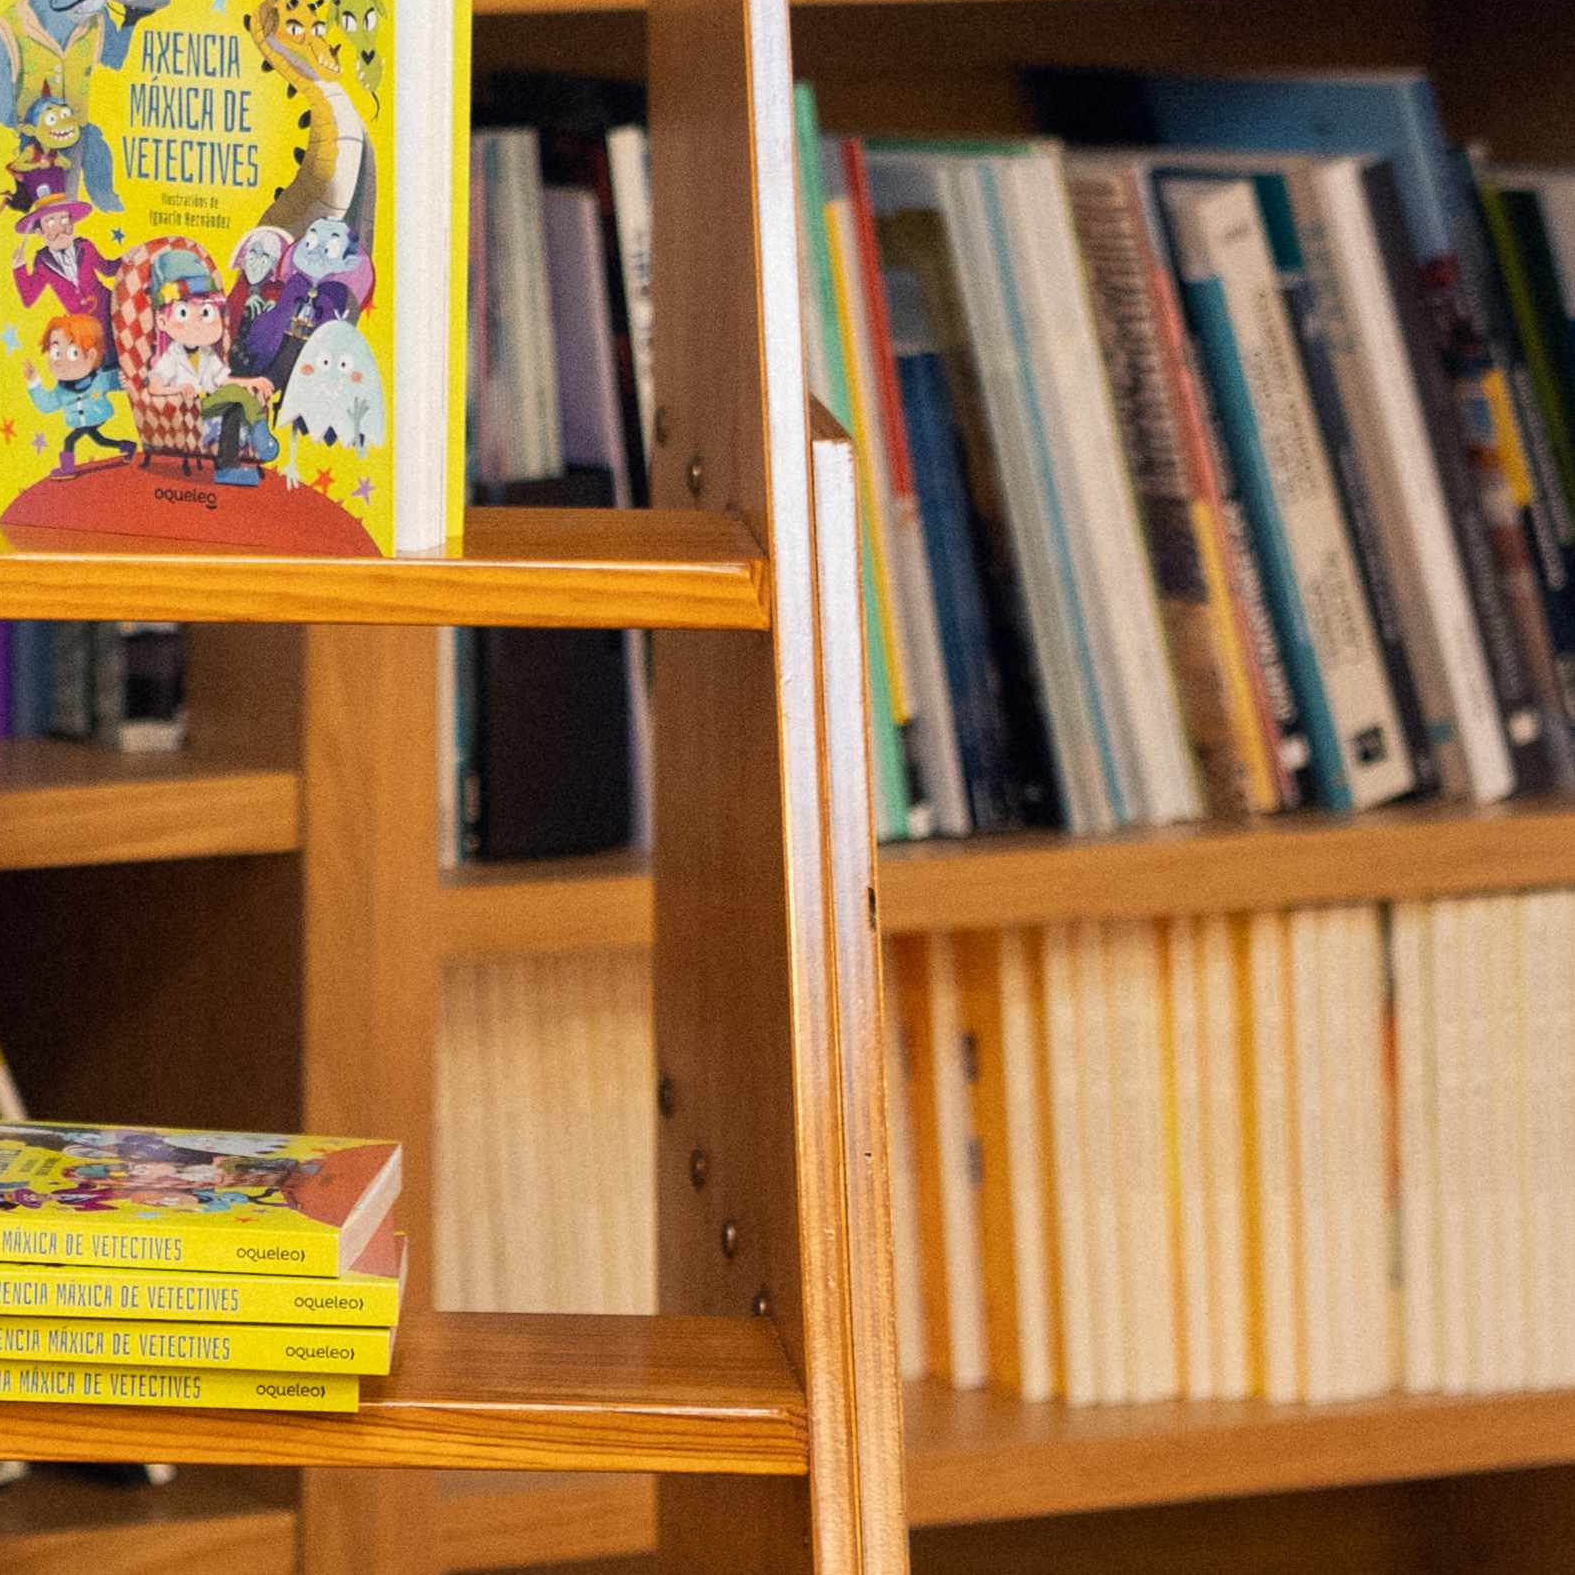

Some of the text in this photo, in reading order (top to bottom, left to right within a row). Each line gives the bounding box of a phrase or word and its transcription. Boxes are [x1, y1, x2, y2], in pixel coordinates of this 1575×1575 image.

[142, 30, 240, 79] AXENCIA
[130, 76, 251, 132] MÁXICA DE
[122, 136, 259, 187] VETECTIVES
[210, 196, 219, 209] de
[154, 488, 217, 509] oqueleo
[2, 1226, 57, 1255] MÁXICA
[66, 1233, 83, 1255] DE
[92, 1235, 182, 1261] VETECTIVES
[236, 1247, 305, 1262] oqueleo
[56, 1280, 112, 1307] MÁXICA
[121, 1285, 139, 1309] DE
[147, 1286, 239, 1312] VETECTIVES
[294, 1295, 364, 1311] oqueleo
[48, 1326, 104, 1354] MÁXICA
[112, 1333, 130, 1356] DE
[139, 1334, 231, 1361] VETECTIVES
[285, 1345, 354, 1361] oqueleo
[20, 1365, 74, 1394] MÁXICA
[84, 1373, 100, 1396] DE
[110, 1373, 201, 1399] VETECTIVES
[256, 1383, 325, 1399] oqueleo
